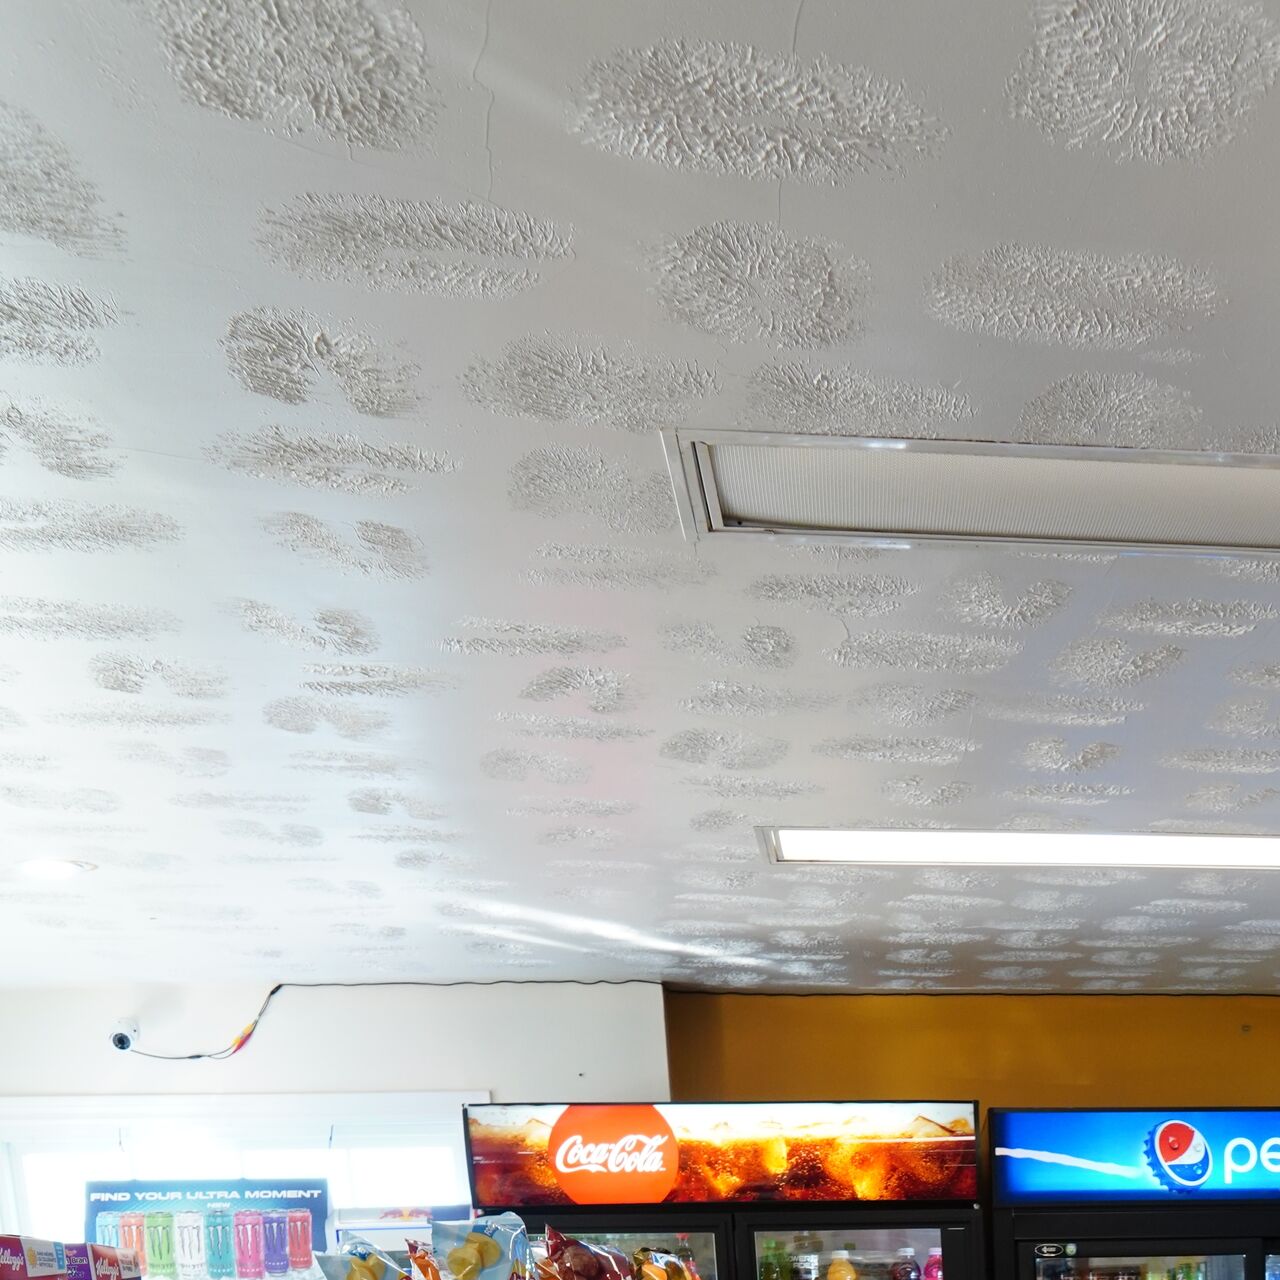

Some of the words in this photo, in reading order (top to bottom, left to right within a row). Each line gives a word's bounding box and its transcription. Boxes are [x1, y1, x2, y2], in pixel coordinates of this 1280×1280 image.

[90, 1191, 131, 1202] FIND
[137, 1191, 183, 1201] YOUR
[186, 1190, 241, 1200] ULTRA
[244, 1189, 322, 1199] MOMENT
